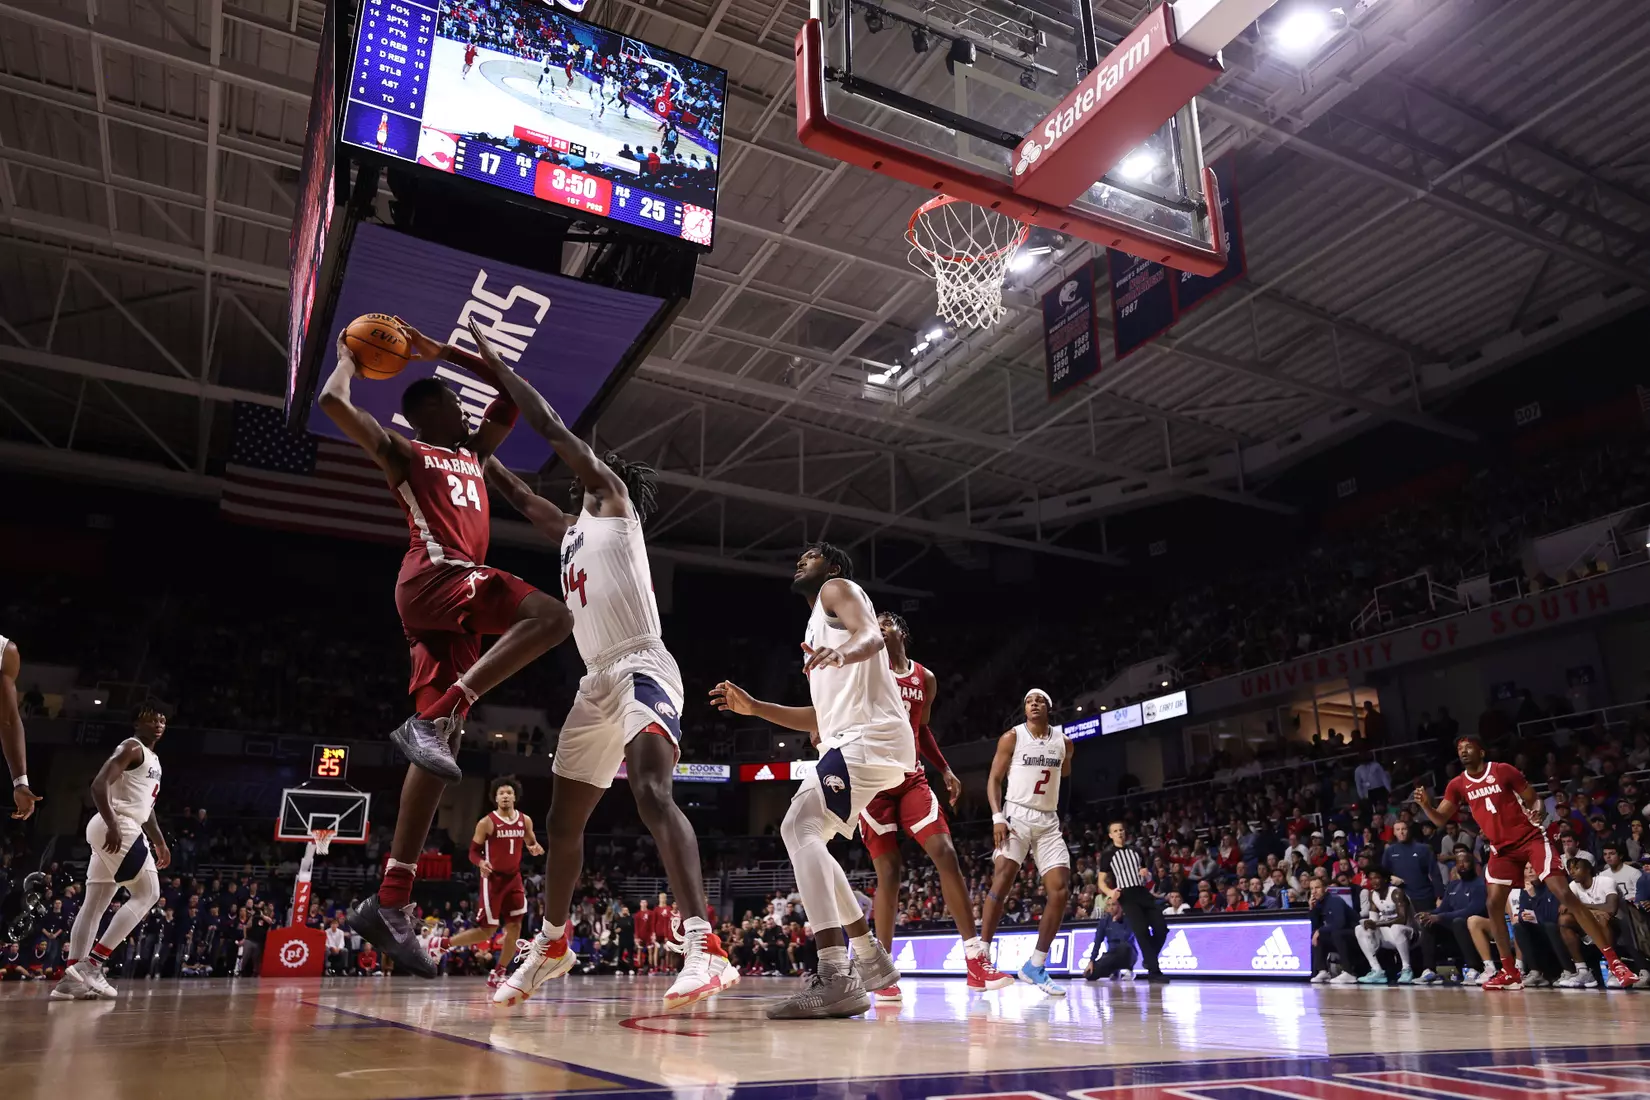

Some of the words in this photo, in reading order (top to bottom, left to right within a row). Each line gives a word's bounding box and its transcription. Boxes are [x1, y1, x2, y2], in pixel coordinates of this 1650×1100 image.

[370, 8, 380, 16] 14
[386, 14, 408, 27] 3PT%
[390, 4, 410, 16] FG%
[421, 14, 431, 22] 30
[389, 27, 406, 38] FT%
[390, 40, 408, 52] REB
[416, 49, 426, 57] 13
[380, 50, 386, 58] D
[388, 53, 406, 64] REB
[379, 64, 401, 76] STLS
[382, 79, 399, 89] AST
[1044, 87, 1093, 150] State
[1096, 34, 1150, 102] Farm
[382, 94, 394, 103] TO
[479, 152, 501, 175] 17
[516, 155, 532, 168] FLS
[552, 169, 596, 199] 3:50
[616, 186, 630, 199] FLS
[566, 197, 580, 206] 1ST
[640, 197, 665, 221] 25
[1121, 299, 1138, 318] 1987
[424, 455, 484, 480] ALABAMA
[447, 474, 481, 512] 24
[1241, 637, 1393, 697] UNIVERSITY
[1422, 622, 1458, 650] OF
[1490, 582, 1610, 634] SOUTH
[1078, 719, 1099, 730] TICKETS
[323, 748, 345, 759] 3:49
[318, 758, 339, 776] 25
[690, 764, 723, 772] COOK'S
[1034, 770, 1050, 795] 2
[1467, 784, 1502, 800] ALABAMA
[1485, 797, 1497, 814] 4
[497, 830, 524, 838] ALABAMA
[510, 839, 514, 854] 1
[287, 948, 301, 961] pf
[1050, 938, 1065, 964] 17
[1158, 956, 1198, 969] adidas
[1251, 956, 1300, 970] adidas
